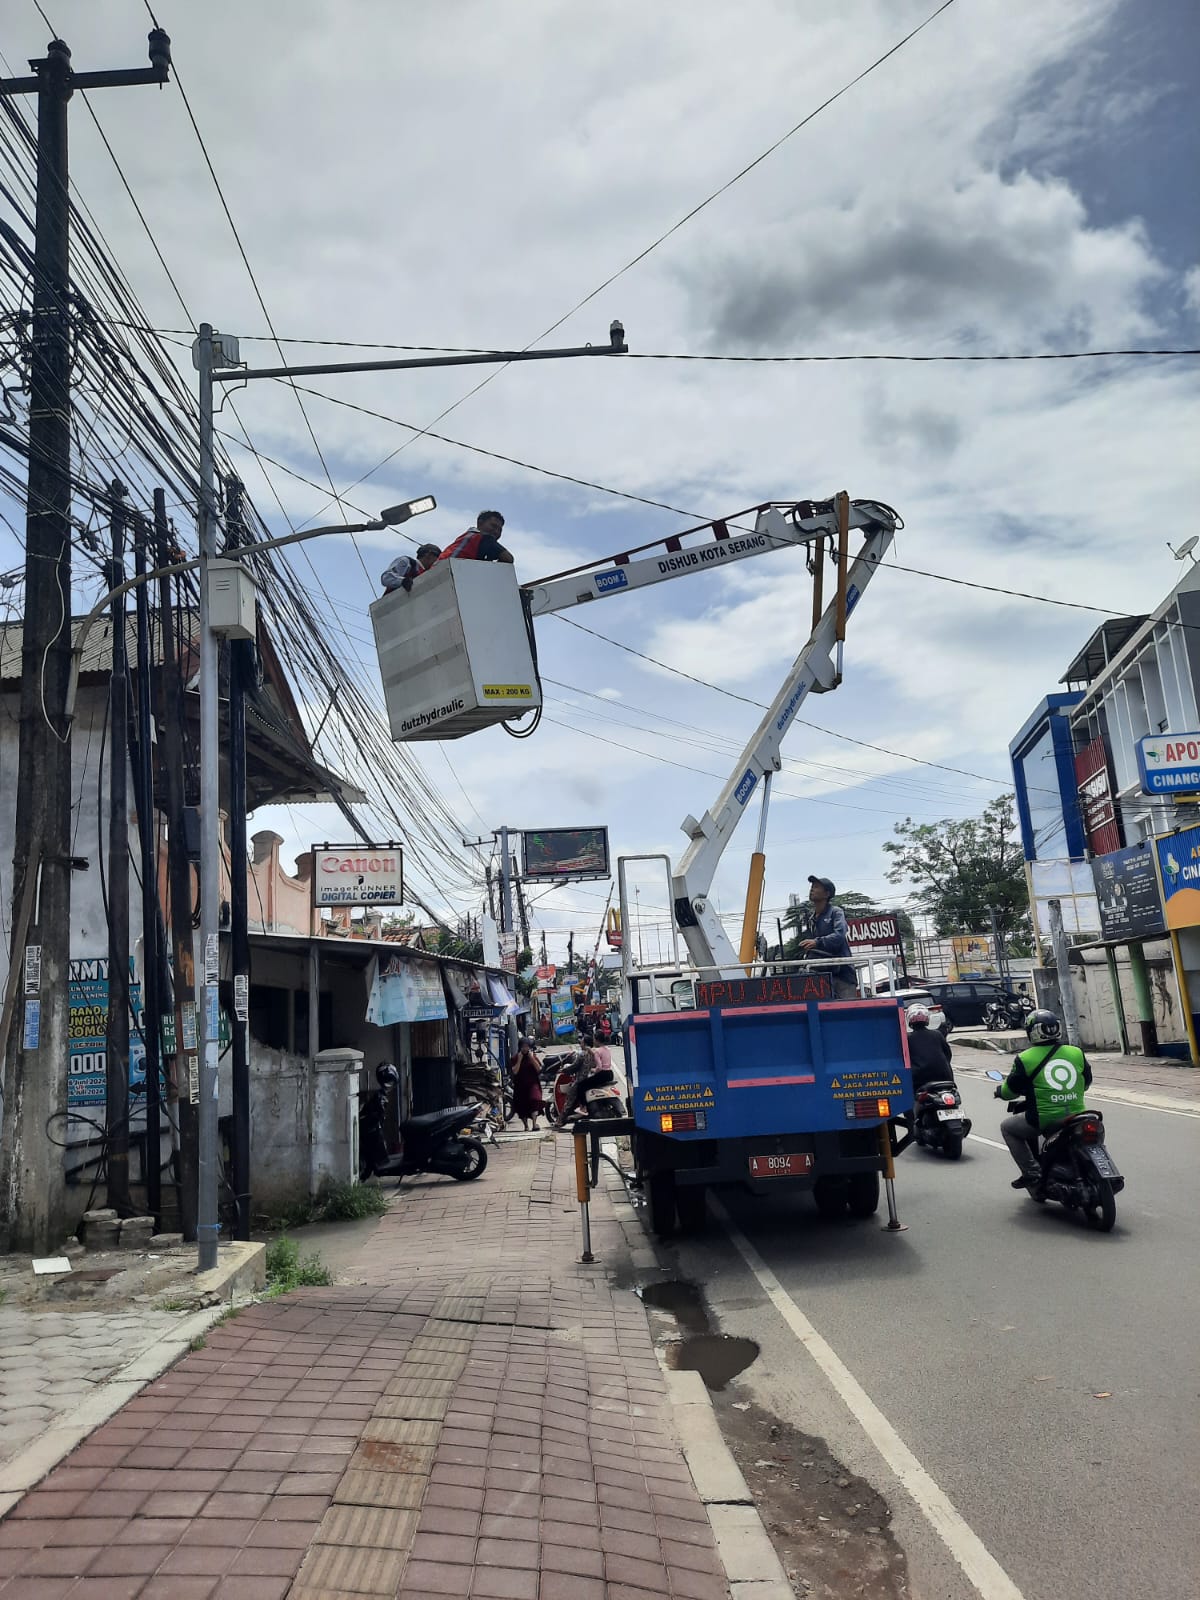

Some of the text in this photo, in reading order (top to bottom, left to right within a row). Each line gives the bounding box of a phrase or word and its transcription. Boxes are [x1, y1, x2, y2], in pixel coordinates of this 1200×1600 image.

[657, 535, 766, 574] DISHUB KOTA SERANG
[596, 573, 627, 588] BOOM 2
[484, 688, 501, 696] MAX
[777, 681, 807, 731] dutzhydraulic
[401, 698, 465, 733] dutzhydraulic
[1153, 772, 1200, 788] CINANG
[737, 776, 753, 802] BOOM
[321, 857, 396, 873] Canon
[321, 891, 396, 901] DIGITAL COPIER
[206, 972, 218, 984] WC
[26, 981, 40, 993] WC
[842, 1072, 879, 1080] HATI-HATI
[655, 1085, 692, 1093] HATI-HATI
[856, 1088, 902, 1097] KENDARAAN
[1051, 1092, 1078, 1103] gojek
[669, 1101, 715, 1110] KENDARAAN
[753, 1154, 811, 1170] A 8094 A
